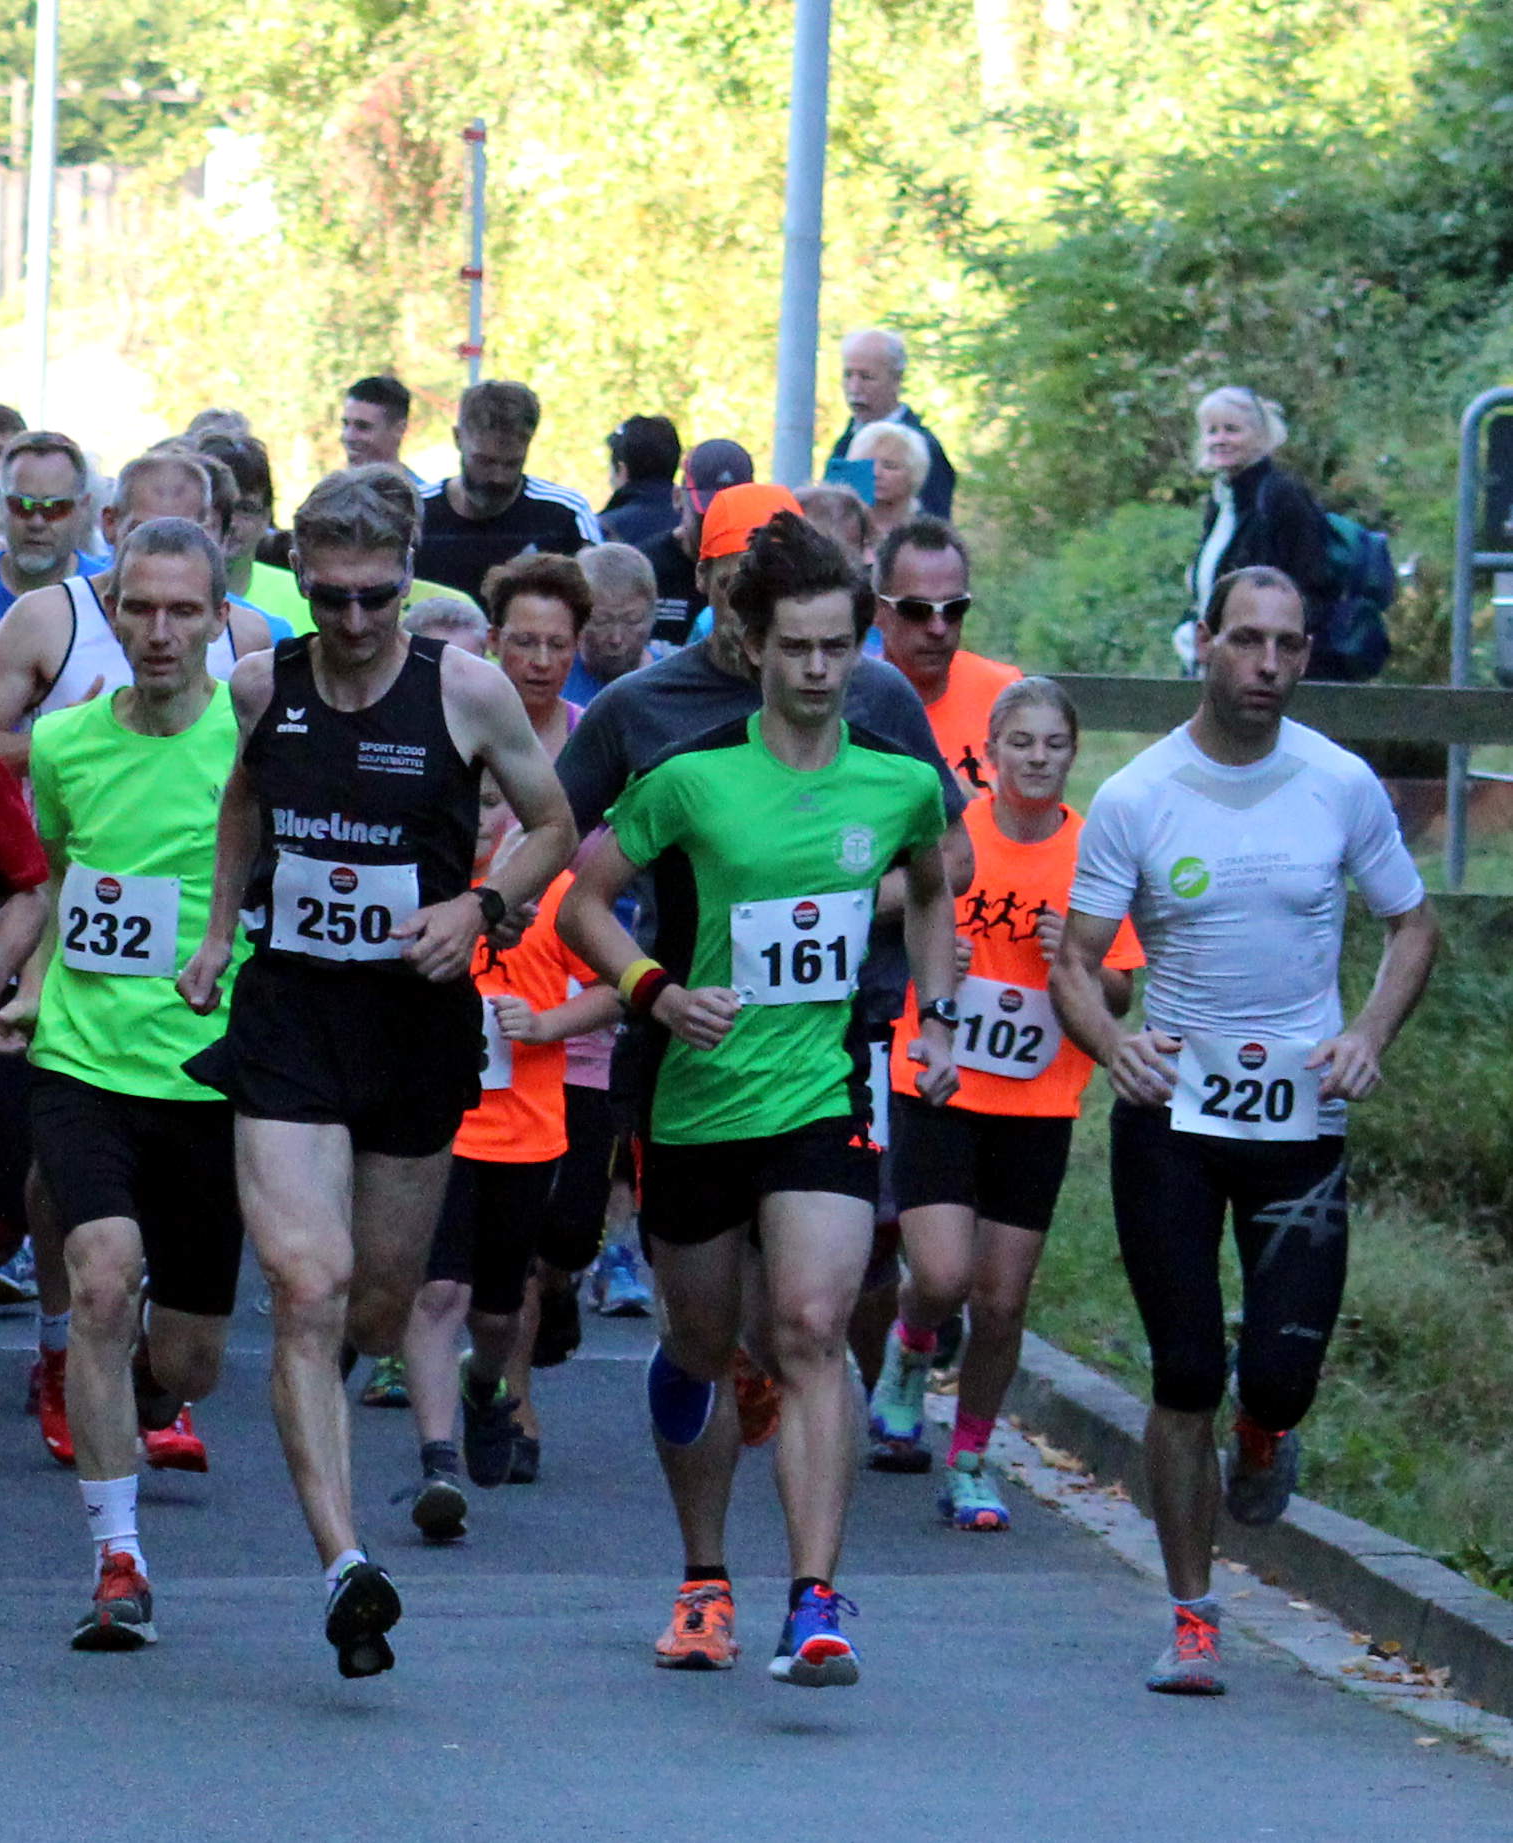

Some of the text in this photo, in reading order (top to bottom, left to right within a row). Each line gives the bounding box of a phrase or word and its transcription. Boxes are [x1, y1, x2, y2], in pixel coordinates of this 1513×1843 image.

[359, 741, 426, 757] SPORT 2000
[66, 906, 151, 959] 232
[296, 896, 392, 945] 250
[761, 935, 847, 986] 161
[964, 1014, 1044, 1063] 102
[1200, 1074, 1294, 1122] 220
